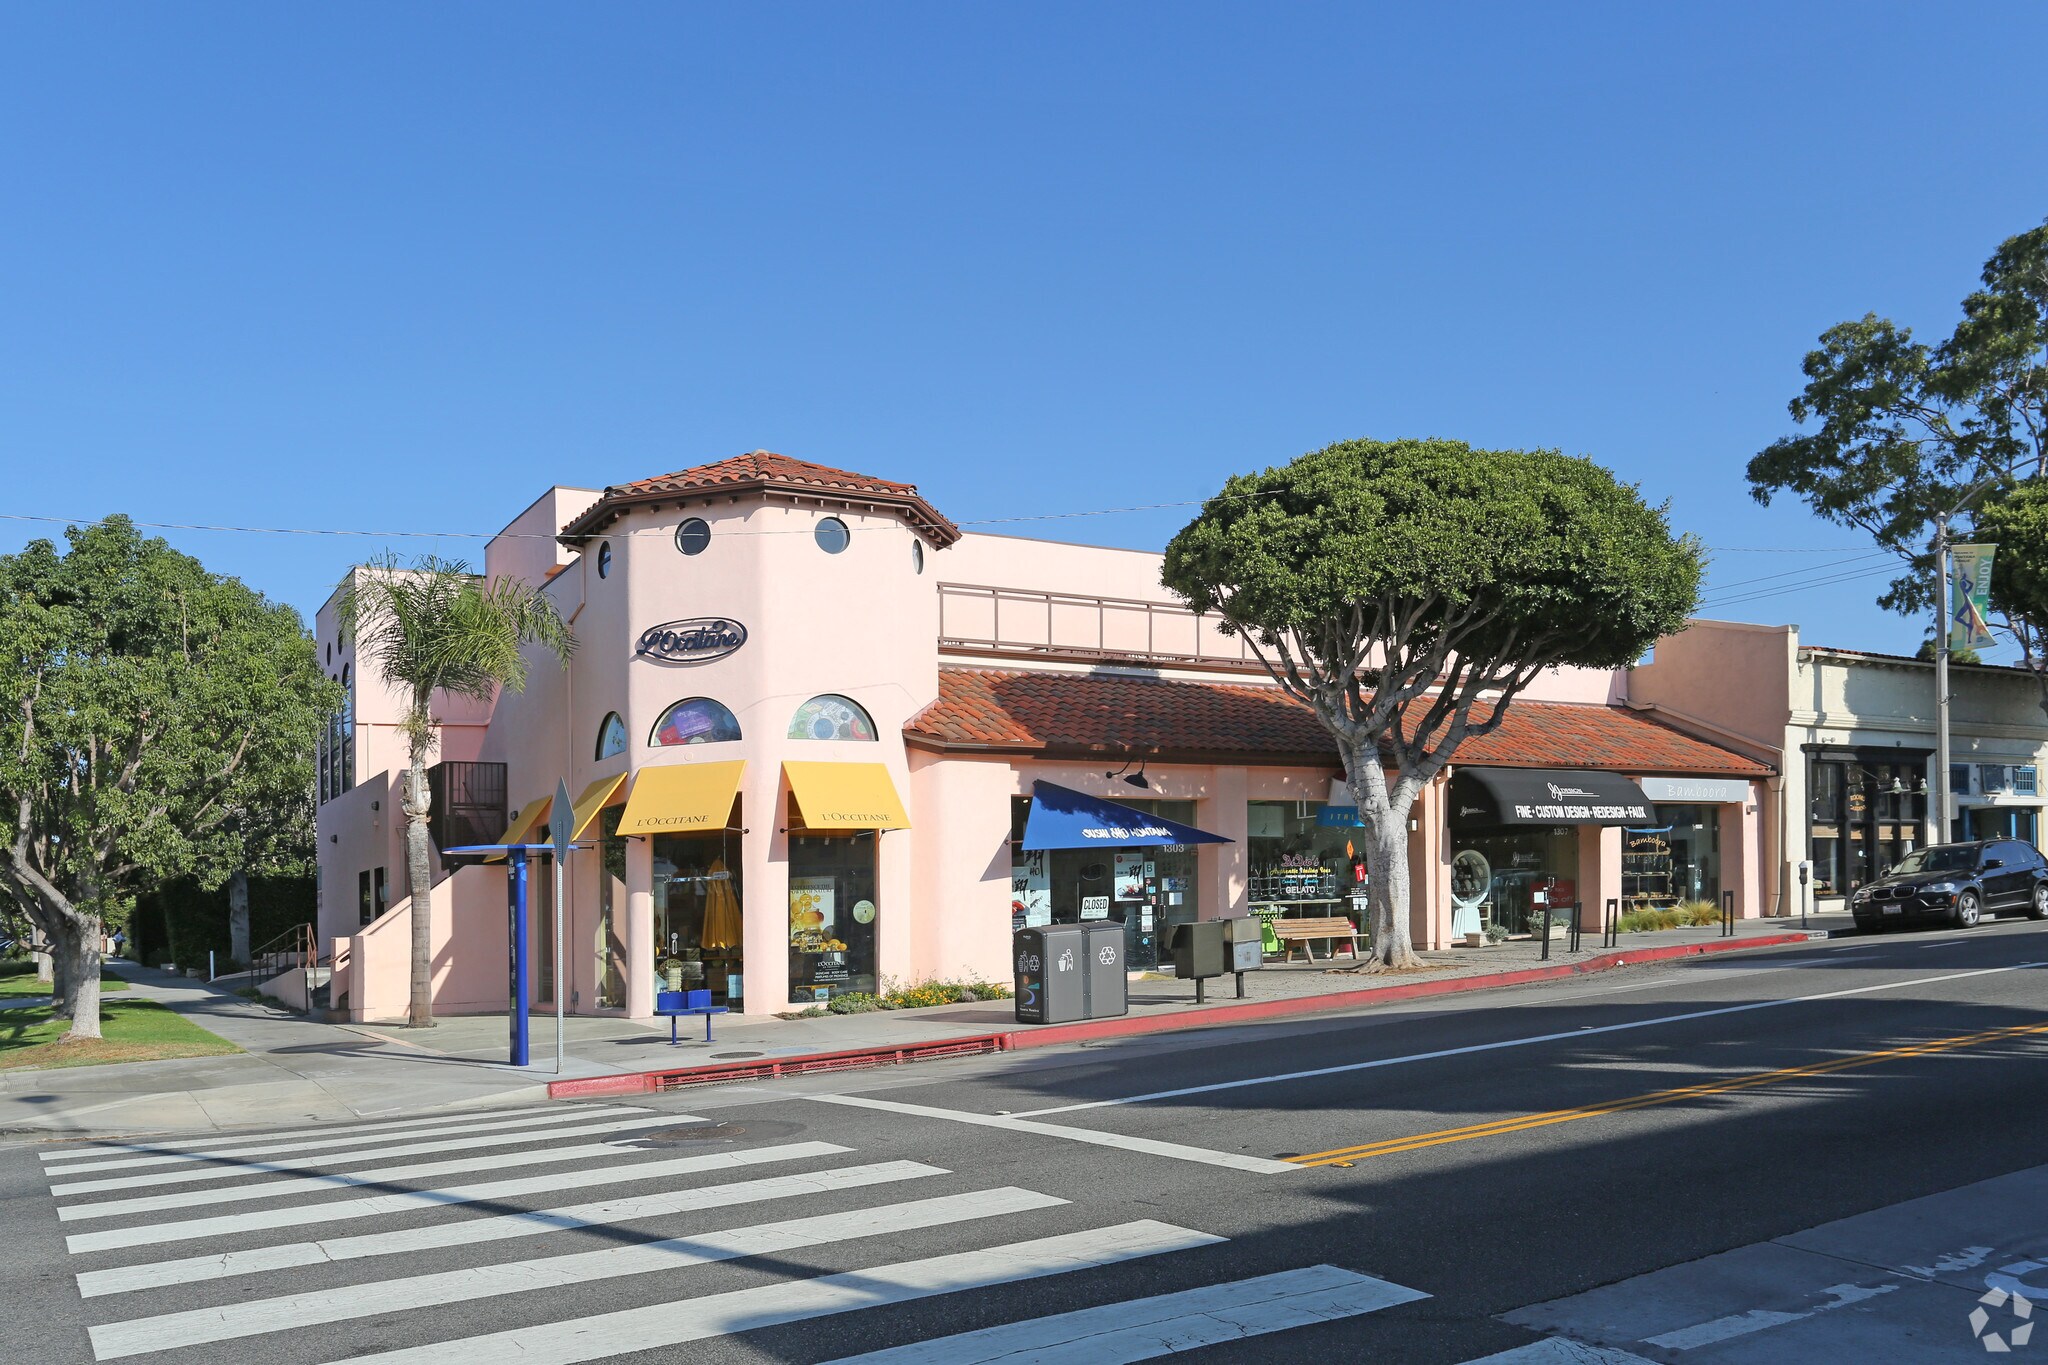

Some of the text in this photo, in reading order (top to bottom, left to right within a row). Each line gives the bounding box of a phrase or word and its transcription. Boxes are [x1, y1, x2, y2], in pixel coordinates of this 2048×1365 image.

[1976, 559, 1992, 596] ENJOY
[637, 620, 741, 656] L'Occitane
[1667, 784, 1727, 797] Bamboora
[821, 812, 892, 822] L'OCCITANE
[1515, 805, 1647, 818] FINE CUSTOM DESIGN REDESIGN FAUX
[637, 815, 709, 827] L'OCCITANE
[1082, 827, 1111, 839] SUSHI
[1553, 828, 1568, 836] 1307
[1163, 844, 1185, 852] 1303
[1286, 886, 1315, 894] GELATO
[1084, 899, 1107, 910] CLOSED
